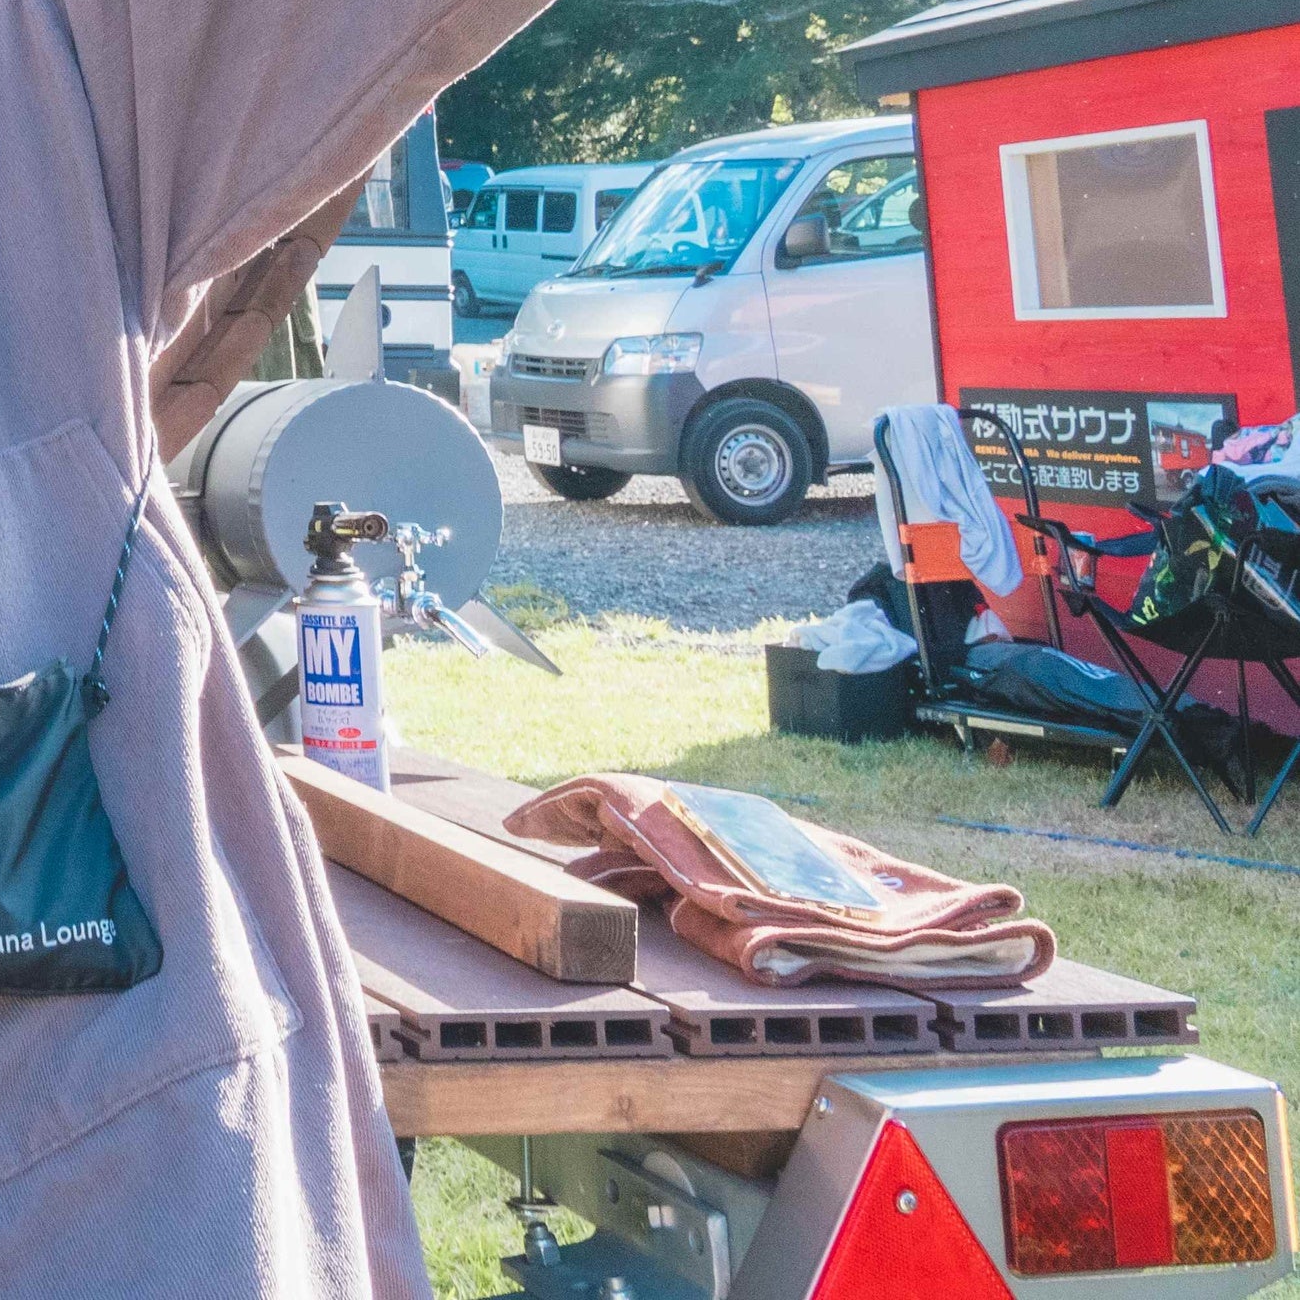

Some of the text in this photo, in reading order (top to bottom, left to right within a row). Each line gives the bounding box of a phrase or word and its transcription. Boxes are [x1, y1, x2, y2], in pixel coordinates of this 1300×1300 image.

[971, 403, 1136, 444] 移動式サウナ
[301, 614, 357, 627] CASSETTE GAS
[304, 628, 356, 677] MY
[307, 681, 360, 704] BOMBE
[40, 918, 117, 947] Lounge
